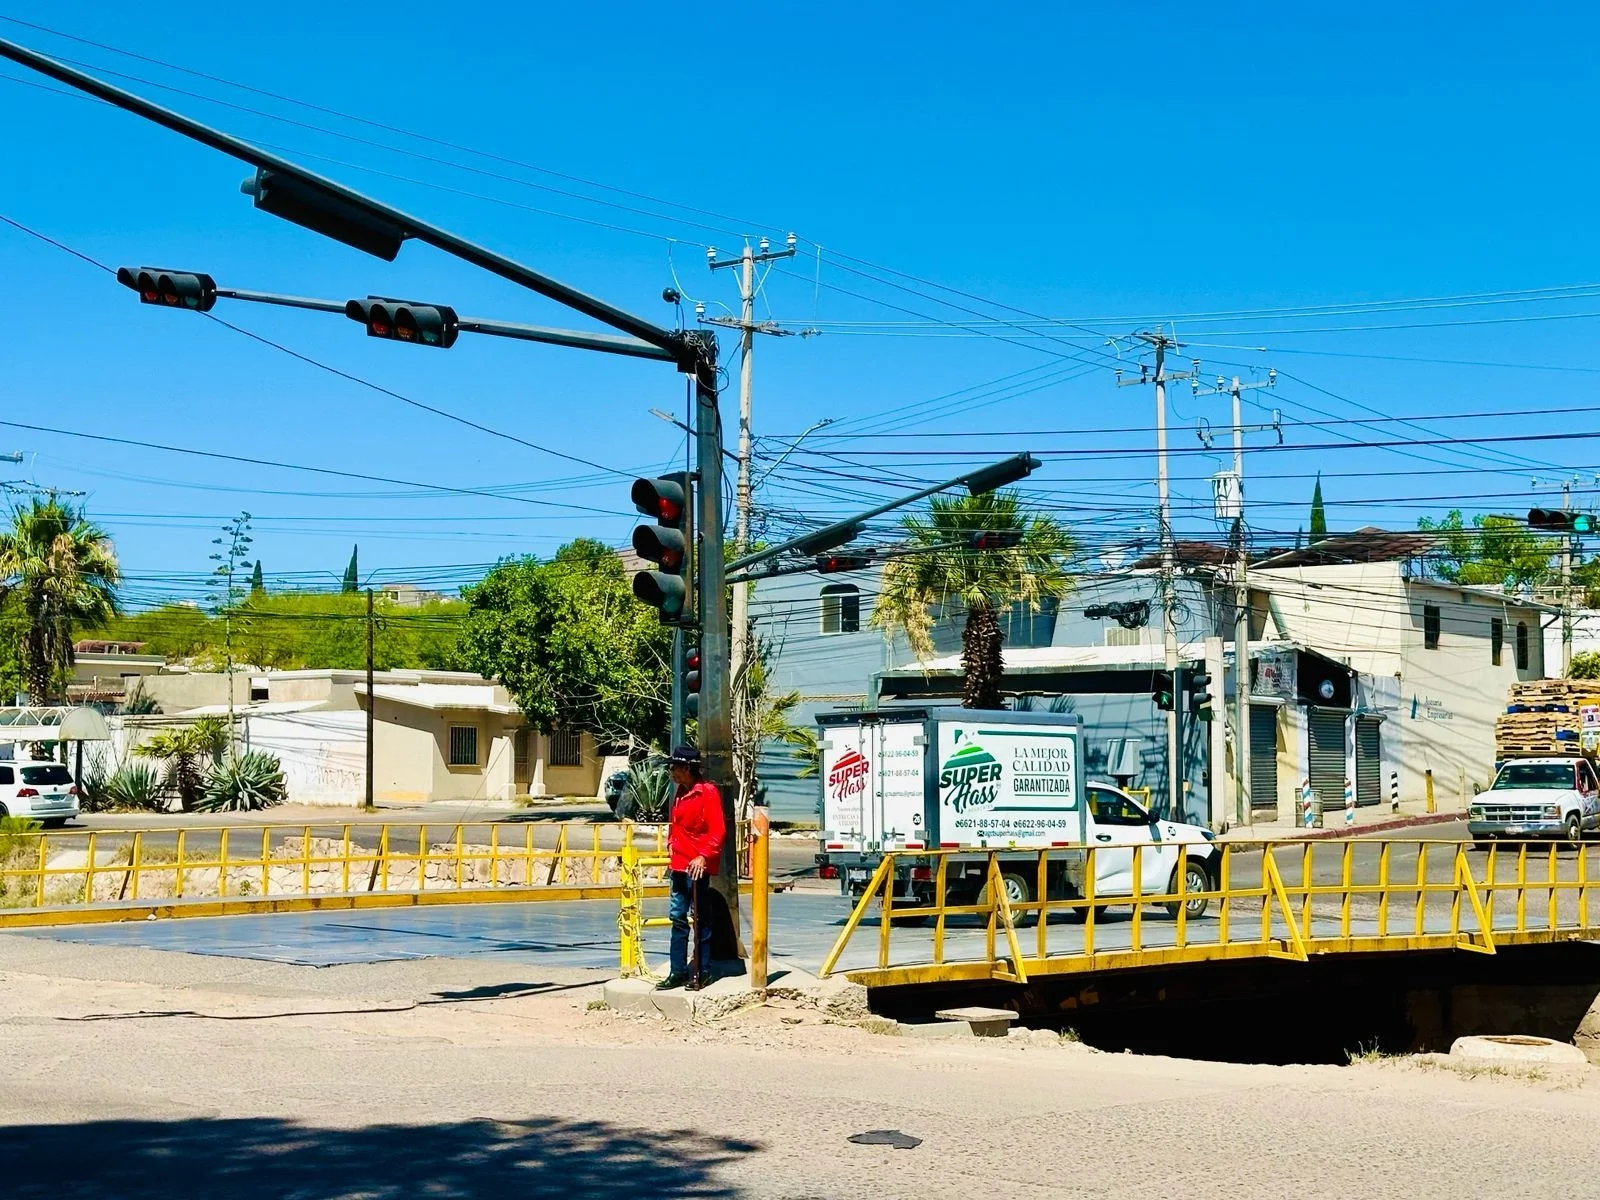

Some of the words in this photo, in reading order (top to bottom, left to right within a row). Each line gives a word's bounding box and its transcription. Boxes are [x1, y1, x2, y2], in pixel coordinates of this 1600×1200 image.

[1014, 747, 1028, 758] LA
[1031, 748, 1068, 760] MEJOR
[828, 761, 869, 787] SUPER
[939, 763, 1003, 788] SUPER
[1012, 760, 1070, 772] CALIDAD
[832, 777, 868, 802] Hass
[1013, 778, 1070, 793] GARANTIZADA
[944, 782, 998, 814] Hass
[960, 819, 1010, 828] 6621-88-57-04
[1017, 819, 1066, 828] 6622-96-04-59
